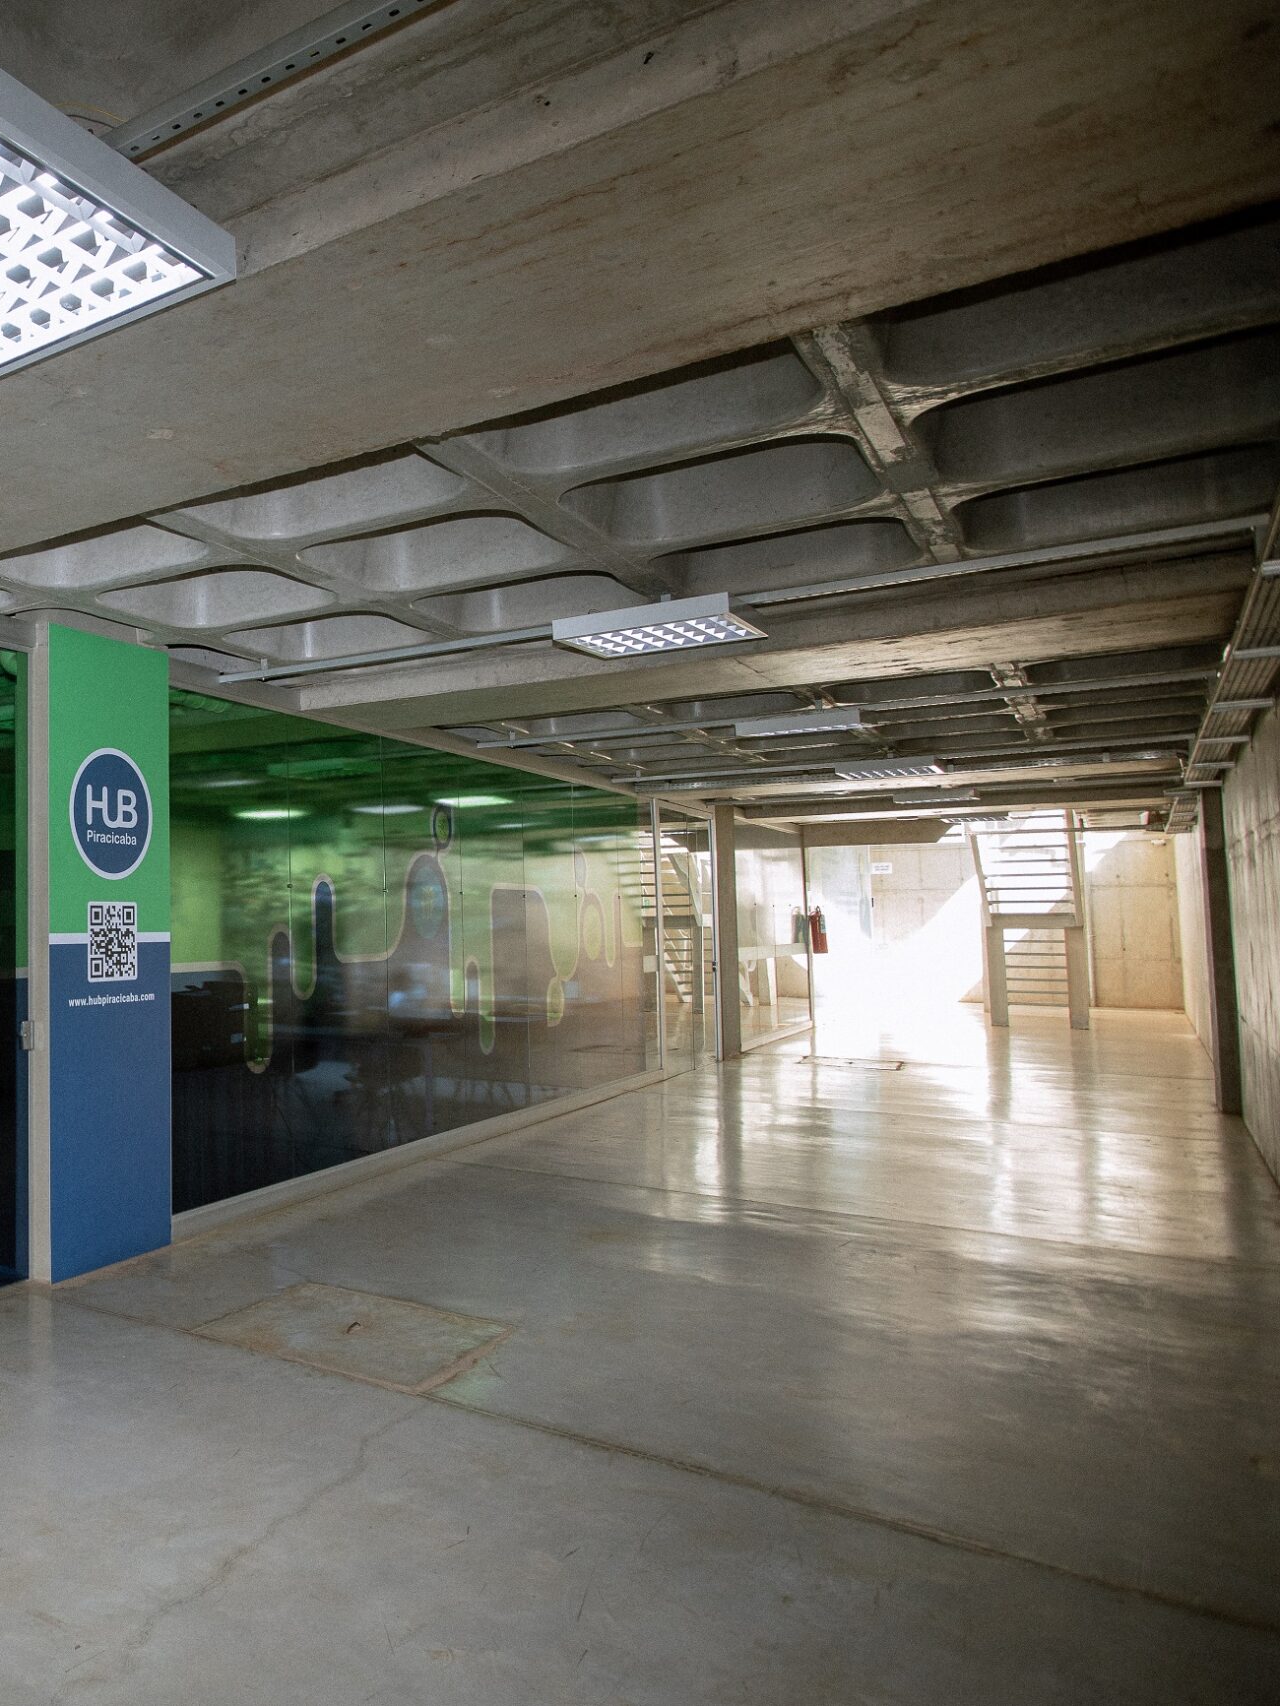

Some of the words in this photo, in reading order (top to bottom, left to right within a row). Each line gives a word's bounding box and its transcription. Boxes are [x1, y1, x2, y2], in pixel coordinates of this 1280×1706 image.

[86, 784, 138, 828] HUB
[86, 829, 137, 846] Piracicaba
[68, 992, 155, 1008] www.hubpiracicaba.com
